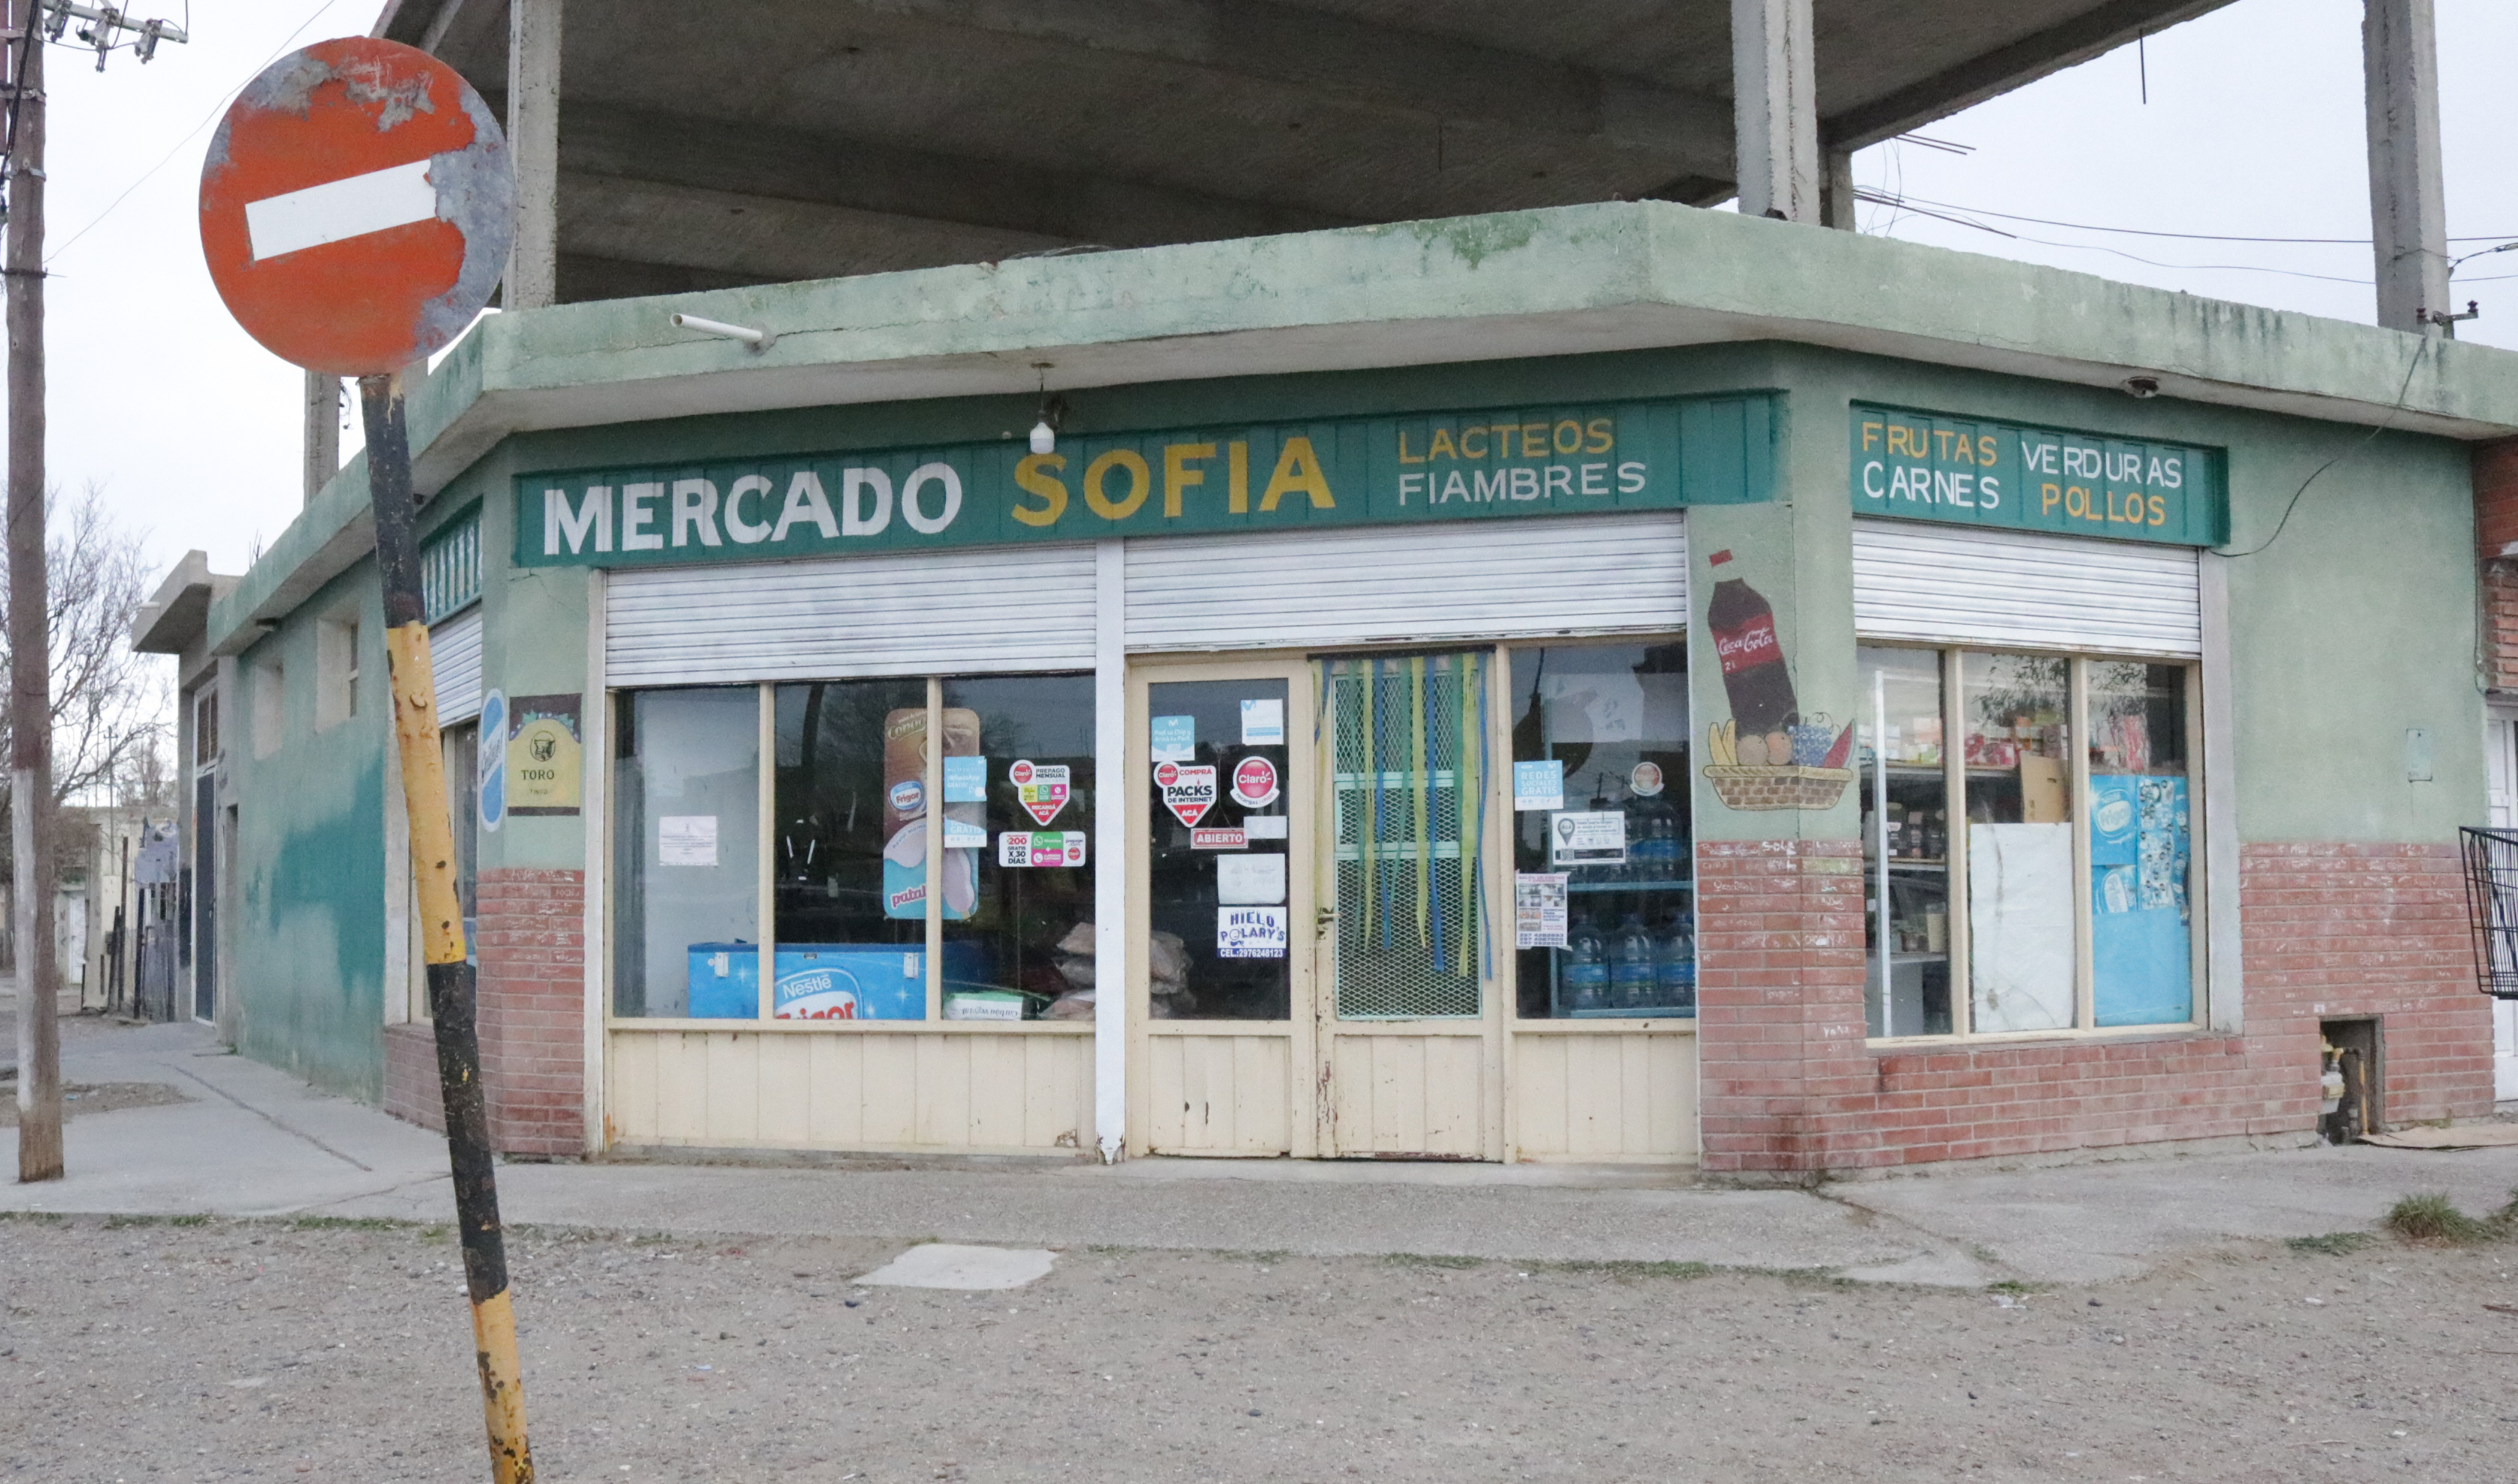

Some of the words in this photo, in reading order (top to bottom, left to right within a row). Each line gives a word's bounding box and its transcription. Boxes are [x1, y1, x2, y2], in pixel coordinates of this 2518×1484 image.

[1398, 418, 1614, 464] LACTEOS
[1862, 422, 1998, 467] FRUTAS
[2021, 441, 2182, 489] VERDURAS
[1399, 462, 1647, 506] FIAMBRES
[1863, 461, 1999, 509] CARNES
[544, 462, 962, 556] MERCADO
[1011, 437, 1335, 527] SOFIA
[2041, 483, 2165, 526] POLLOS
[521, 770, 554, 780] TORO
[1239, 774, 1269, 783] Claro
[1521, 771, 1556, 780] REDES
[896, 792, 920, 804] Frigor
[1168, 786, 1213, 796] PACKS
[1522, 786, 1557, 795] GRATIS
[1235, 793, 1259, 805] recargas
[1181, 809, 1198, 817] ACÁ
[1197, 834, 1243, 843] ABIERTO
[892, 886, 926, 908] patal
[1230, 911, 1274, 927] HIELO
[783, 974, 832, 999] Nestlé
